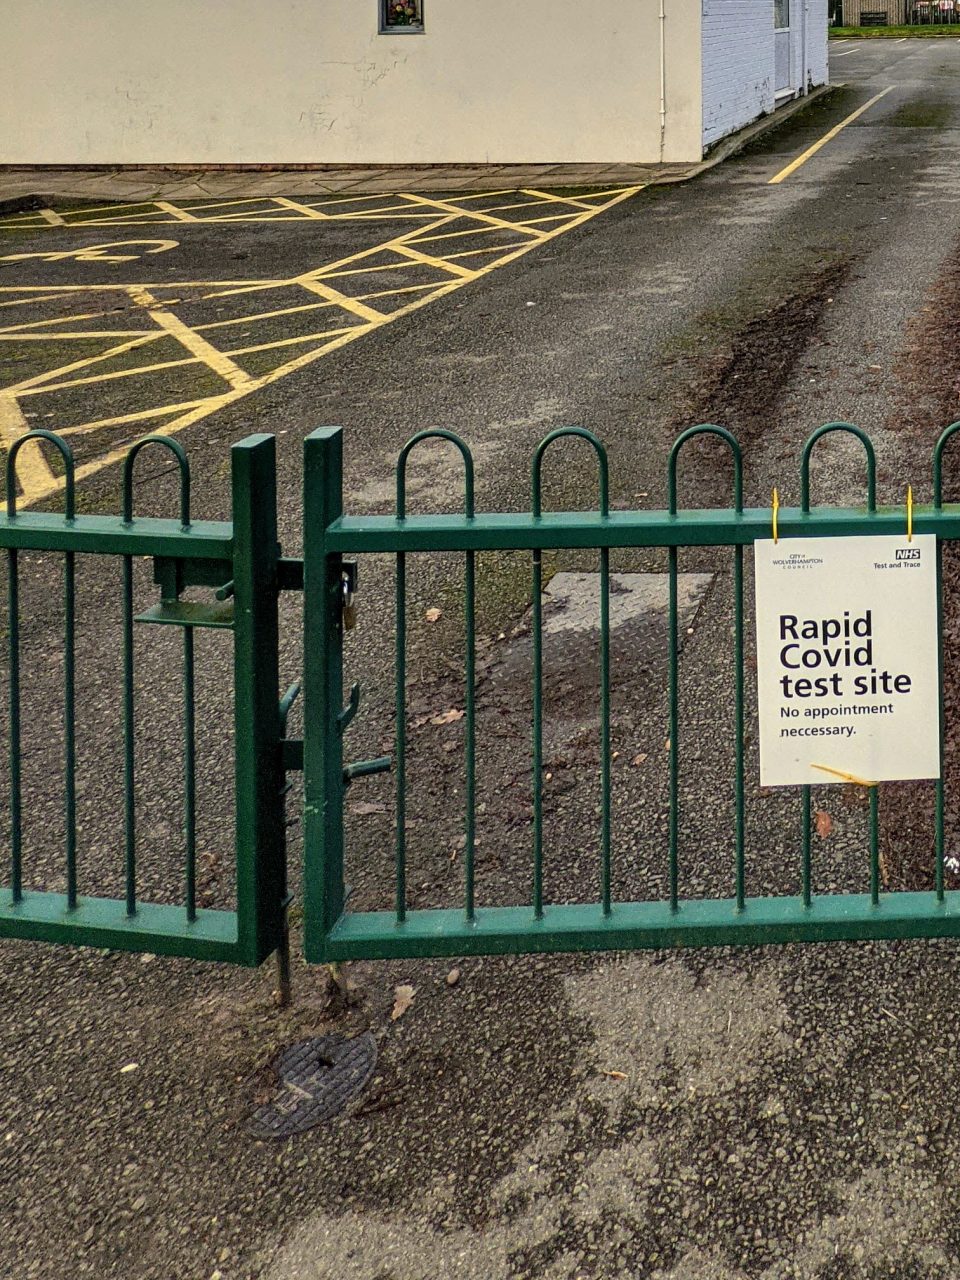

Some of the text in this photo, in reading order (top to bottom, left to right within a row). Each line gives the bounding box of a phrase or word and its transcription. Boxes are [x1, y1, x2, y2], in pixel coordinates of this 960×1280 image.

[896, 549, 920, 560] NHS
[780, 610, 872, 645] Rapid
[780, 639, 873, 669] Covid
[780, 669, 912, 698] test site
[780, 704, 894, 719] No appointment
[780, 725, 856, 737] neccessary.
